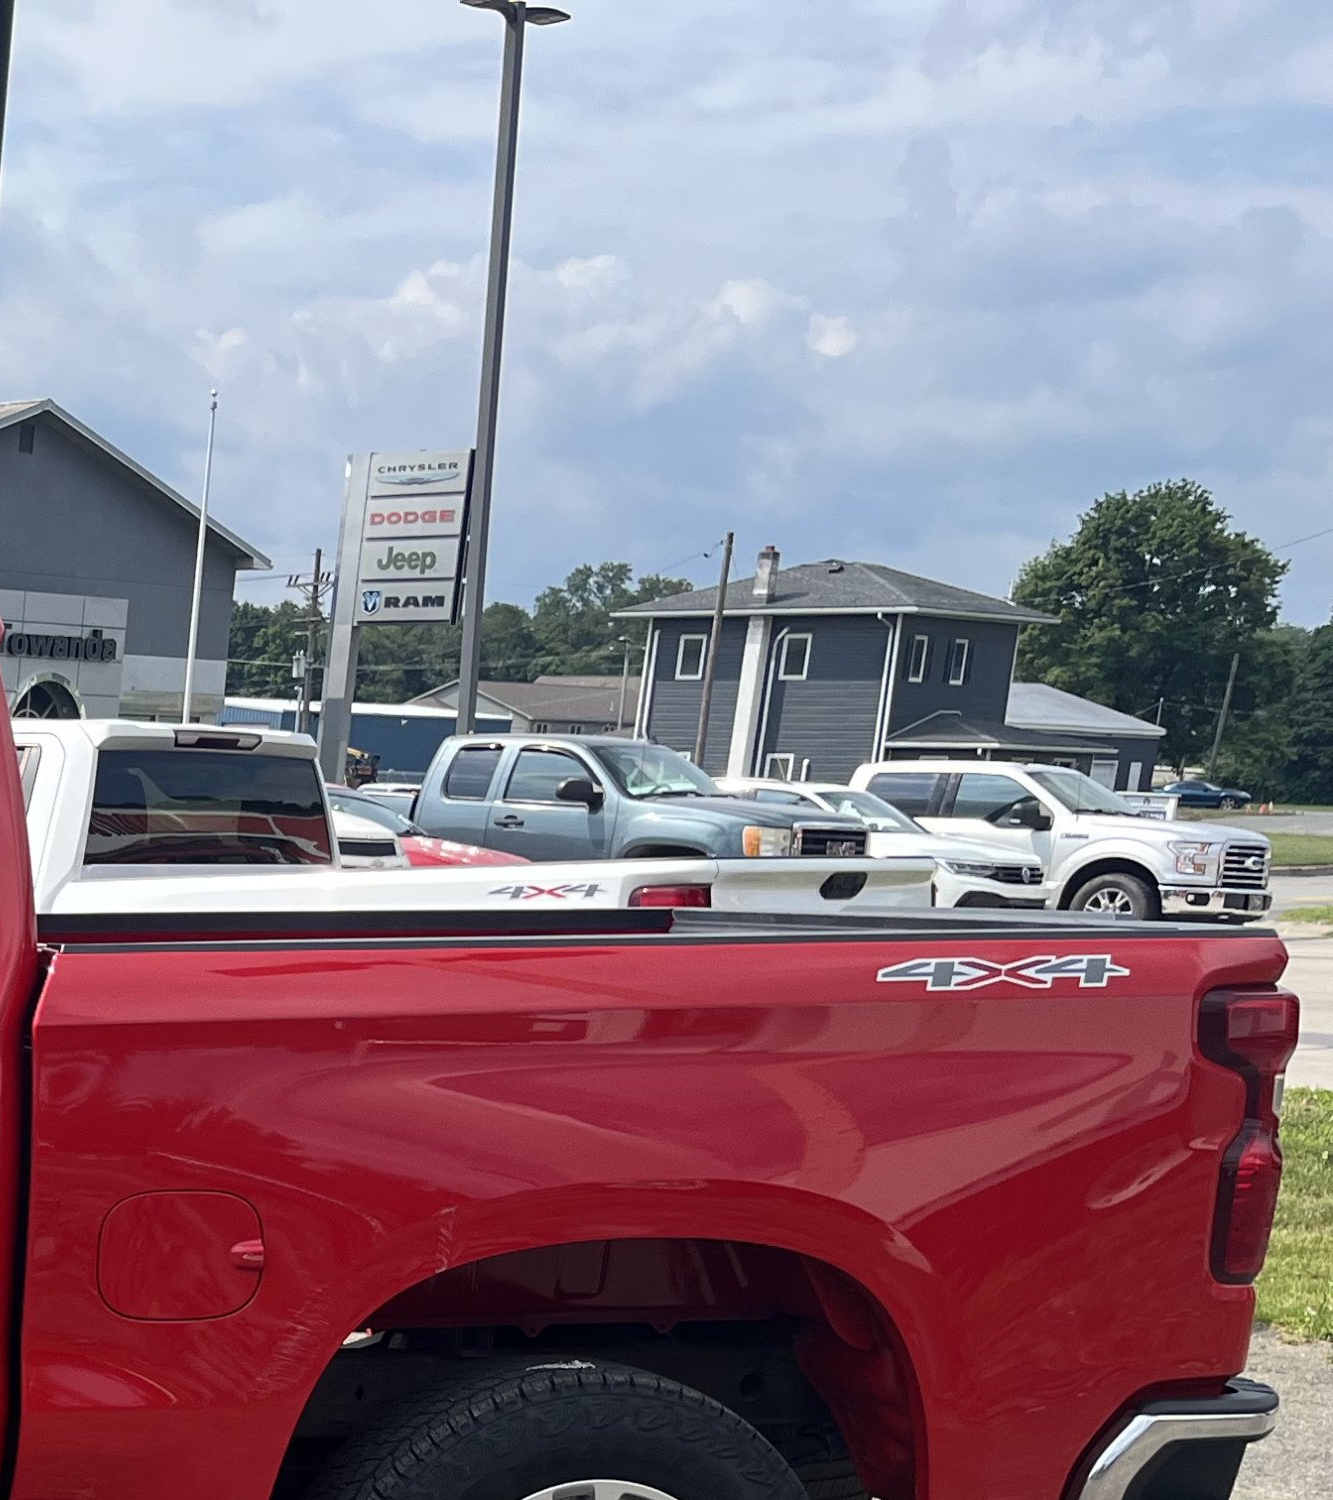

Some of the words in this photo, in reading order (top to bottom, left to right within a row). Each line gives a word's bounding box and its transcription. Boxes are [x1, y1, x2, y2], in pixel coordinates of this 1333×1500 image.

[378, 462, 458, 474] CHRYSLER
[370, 510, 455, 525] DODGE
[377, 547, 436, 574] Jeep
[384, 596, 445, 608] RAM
